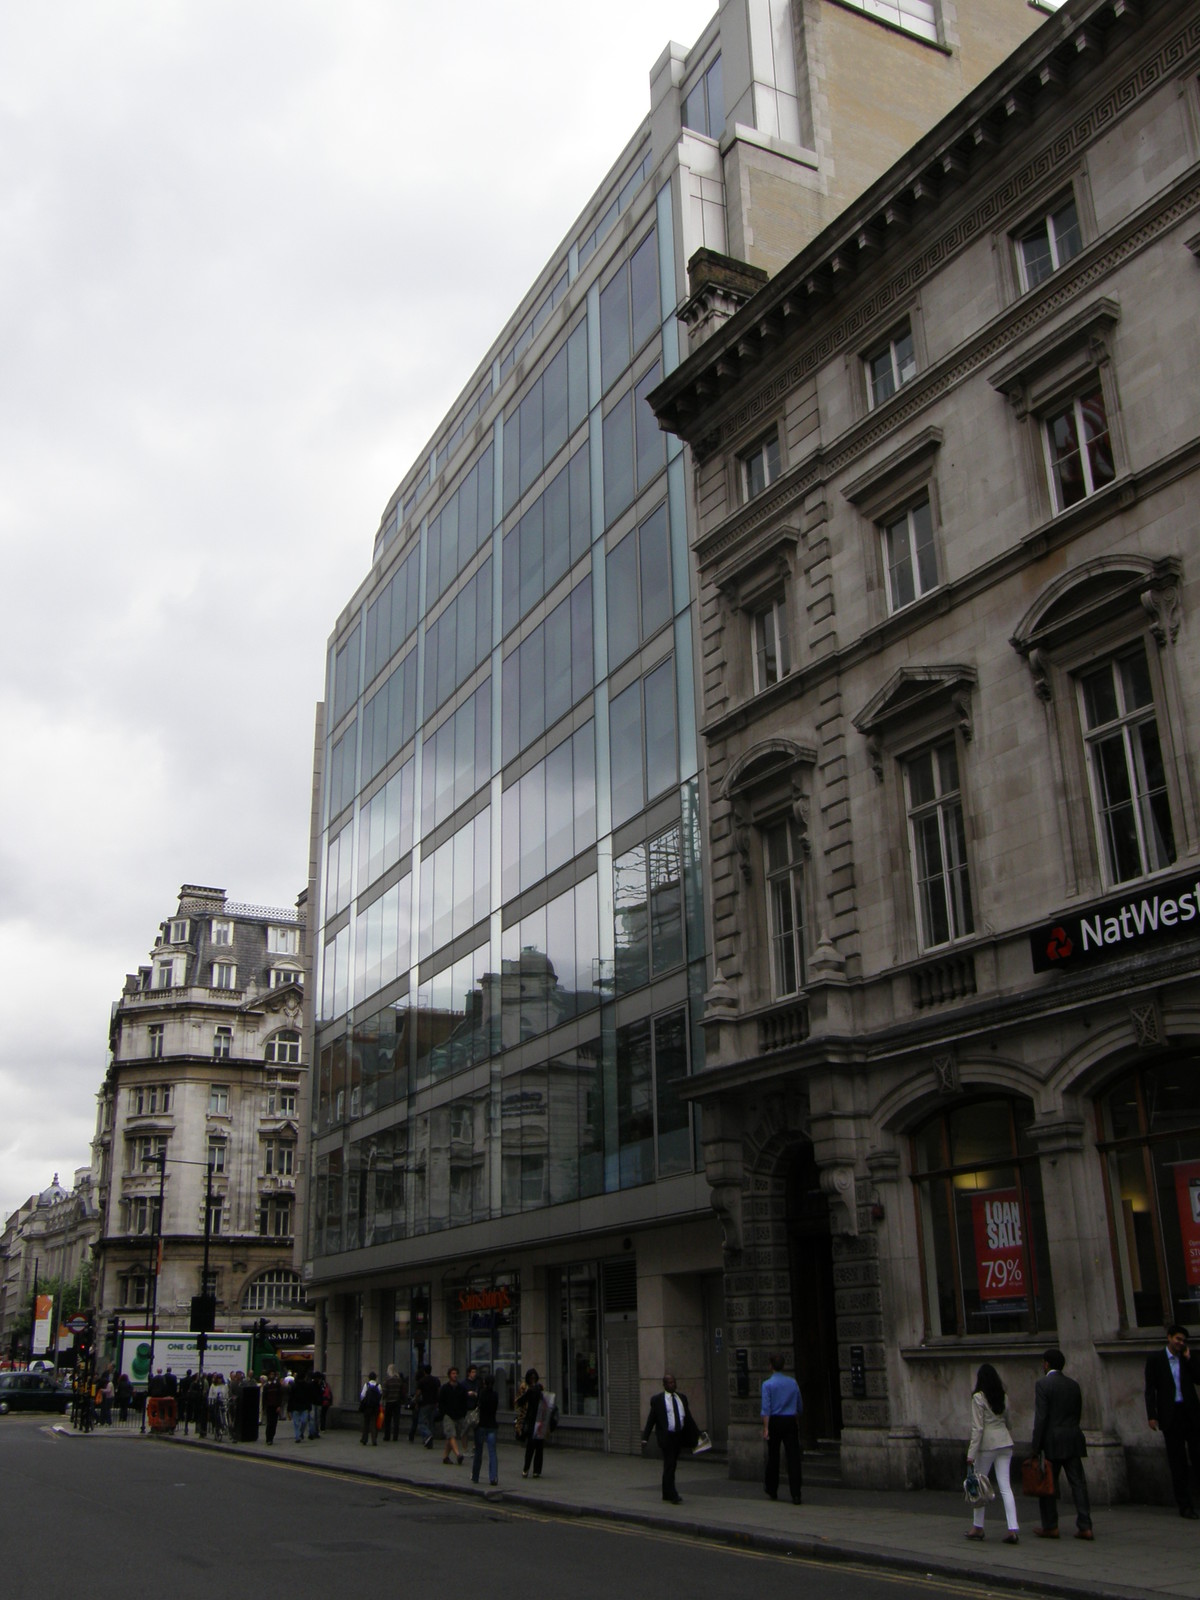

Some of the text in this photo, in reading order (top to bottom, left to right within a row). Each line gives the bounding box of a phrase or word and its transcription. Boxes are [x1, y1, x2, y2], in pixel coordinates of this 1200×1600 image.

[985, 1200, 1020, 1224] LOAN
[987, 1222, 1022, 1249] SALE
[981, 1259, 1022, 1288] 7.9%
